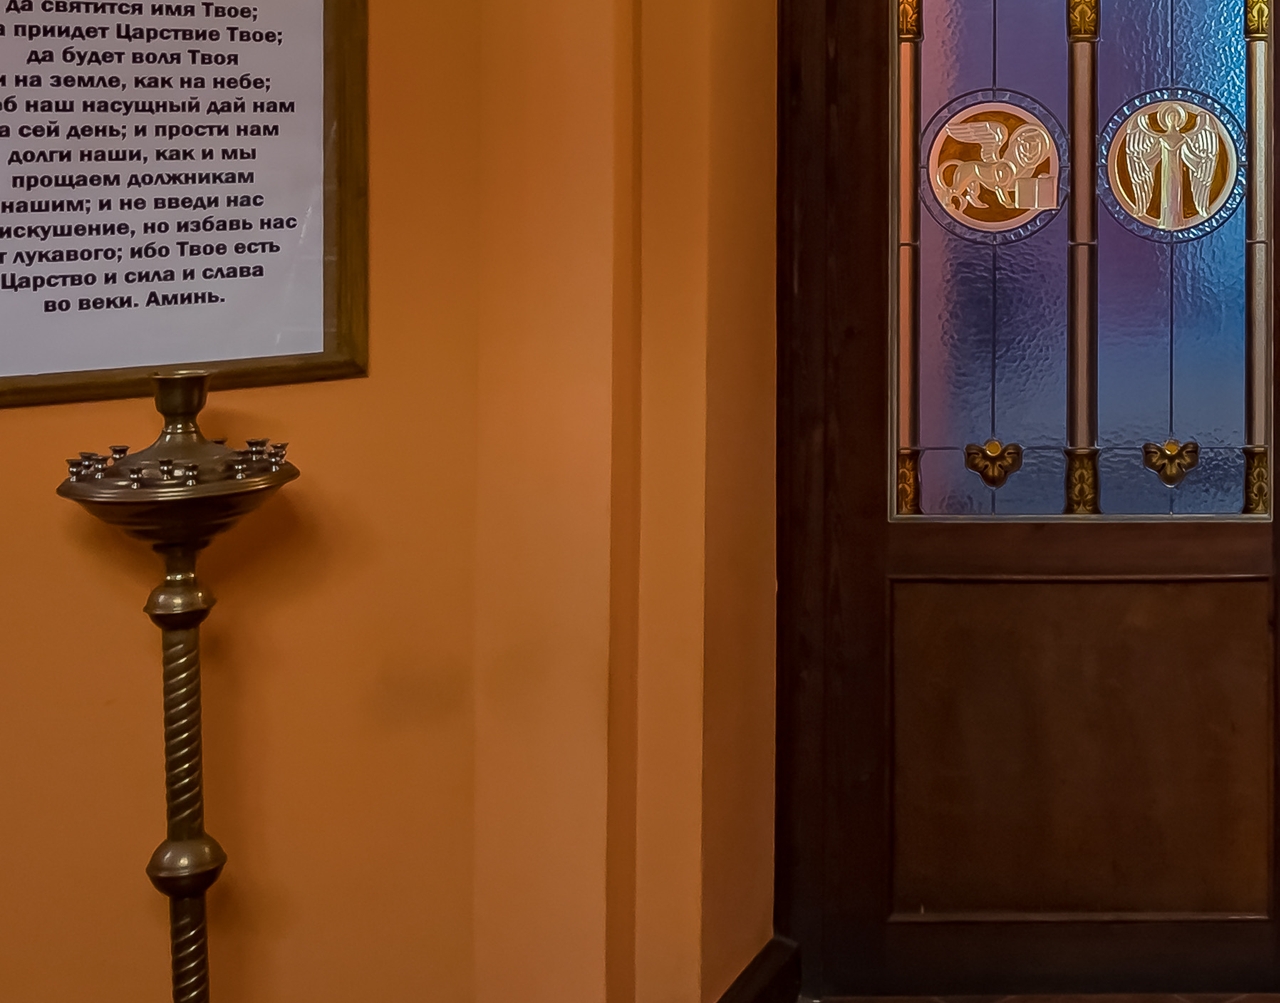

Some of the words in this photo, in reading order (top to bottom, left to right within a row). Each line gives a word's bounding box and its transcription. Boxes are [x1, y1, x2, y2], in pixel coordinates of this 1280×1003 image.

[40, 0, 144, 16] святится
[150, 3, 196, 17] имя
[201, 1, 258, 23] Твое;
[13, 24, 110, 41] приидет
[116, 23, 221, 44] Царствие
[225, 26, 283, 46] Твое;
[26, 49, 55, 65] да
[61, 45, 126, 67] будет
[131, 51, 182, 65] воля
[187, 49, 239, 66] Твоя
[14, 74, 42, 88] на
[49, 74, 127, 92] земле,
[133, 76, 174, 89] как
[179, 76, 206, 89] на
[212, 72, 271, 93] небе;
[0, 94, 18, 113] б
[25, 99, 75, 113] наш
[82, 96, 201, 117] насущный
[206, 96, 246, 116] дай
[252, 100, 295, 113] нам
[18, 120, 60, 138] сей
[65, 124, 127, 141] день;
[134, 124, 147, 138] и
[154, 124, 230, 141] прости
[236, 124, 279, 137] нам
[7, 149, 72, 166] долги
[79, 149, 148, 165] наши,
[155, 148, 196, 162] как
[201, 148, 214, 161] и
[221, 148, 257, 160] мы
[11, 173, 121, 192] прощаем
[126, 171, 255, 189] должникам
[0, 199, 91, 215] нашим;
[98, 198, 112, 212] и
[119, 197, 147, 211] не
[153, 196, 220, 211] введи
[226, 194, 265, 208] нас
[0, 222, 136, 242] искушение,
[143, 221, 170, 235] но
[176, 215, 254, 233] избавь
[259, 216, 298, 230] нас
[12, 247, 123, 267] лукавого;
[129, 241, 170, 259] ибо
[175, 241, 228, 257] Твое
[233, 241, 281, 255] есть
[0, 272, 97, 293] Царство
[103, 272, 118, 285] и
[124, 269, 175, 284] сила
[182, 268, 195, 281] и
[201, 265, 264, 280] слава
[43, 299, 71, 313] во
[77, 295, 139, 311] веки.
[145, 290, 226, 308] Аминь.
